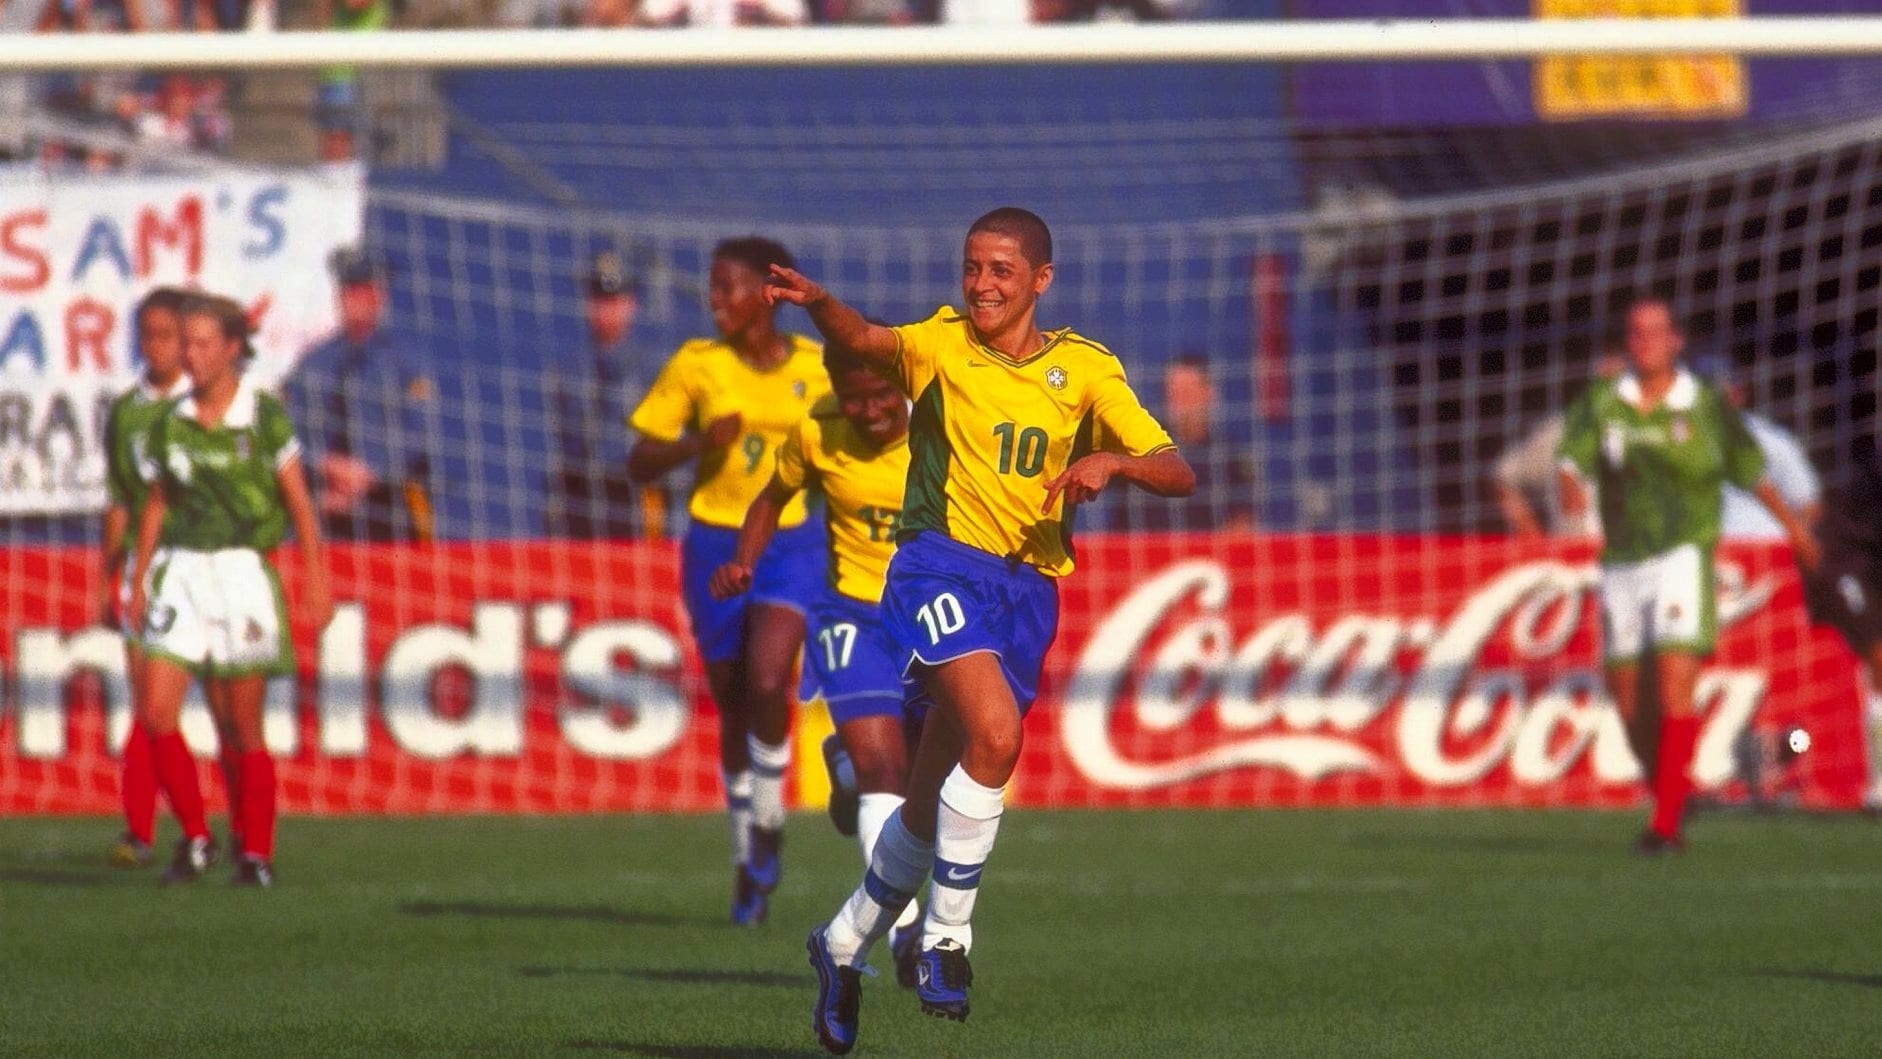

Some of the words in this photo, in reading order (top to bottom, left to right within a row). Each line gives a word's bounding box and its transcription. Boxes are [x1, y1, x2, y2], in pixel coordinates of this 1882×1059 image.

[0, 185, 288, 292] SAM'S
[742, 433, 765, 472] 9
[993, 421, 1049, 478] 10
[916, 592, 966, 645] 10
[818, 622, 857, 672] 17
